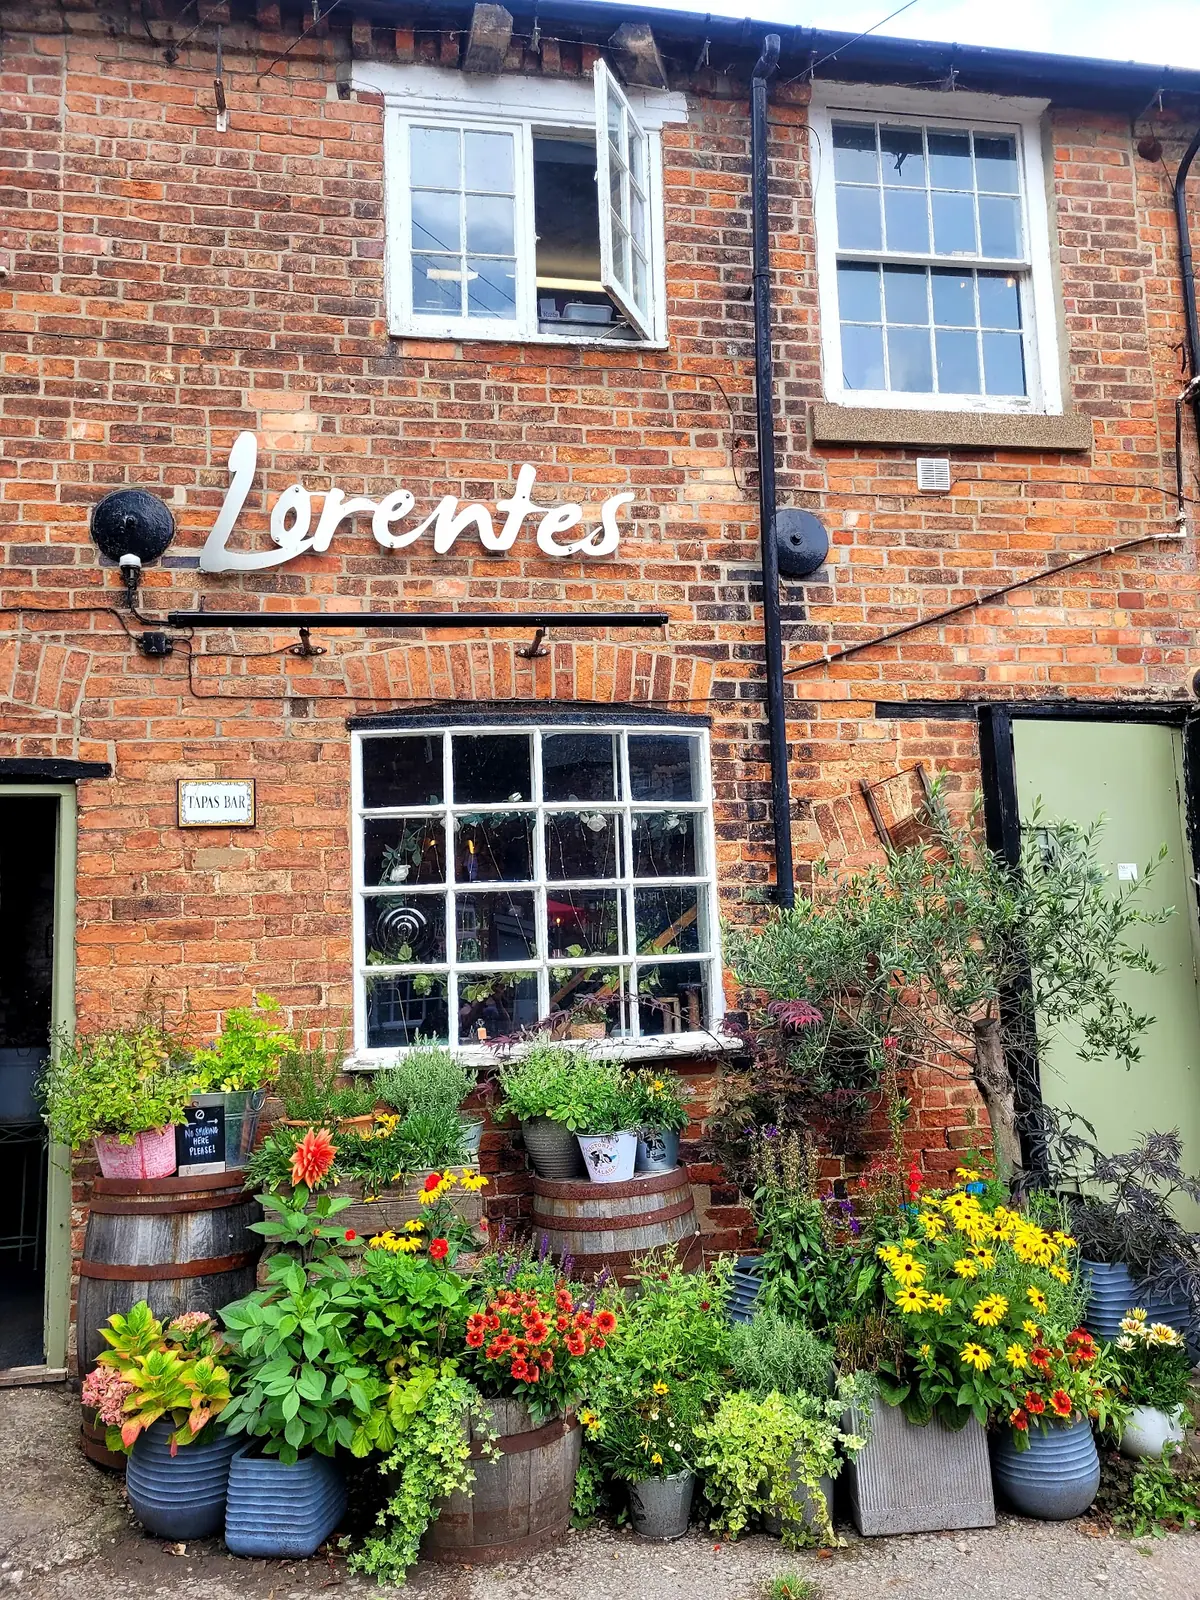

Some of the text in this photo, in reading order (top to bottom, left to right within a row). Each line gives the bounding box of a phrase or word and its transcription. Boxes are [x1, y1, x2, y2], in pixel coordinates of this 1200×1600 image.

[199, 430, 636, 572] Lorentes
[187, 795, 246, 809] TAPAS BAR
[195, 1126, 219, 1136] SMOKING
[192, 1136, 210, 1146] HERE
[189, 1144, 216, 1156] PLEASE!
